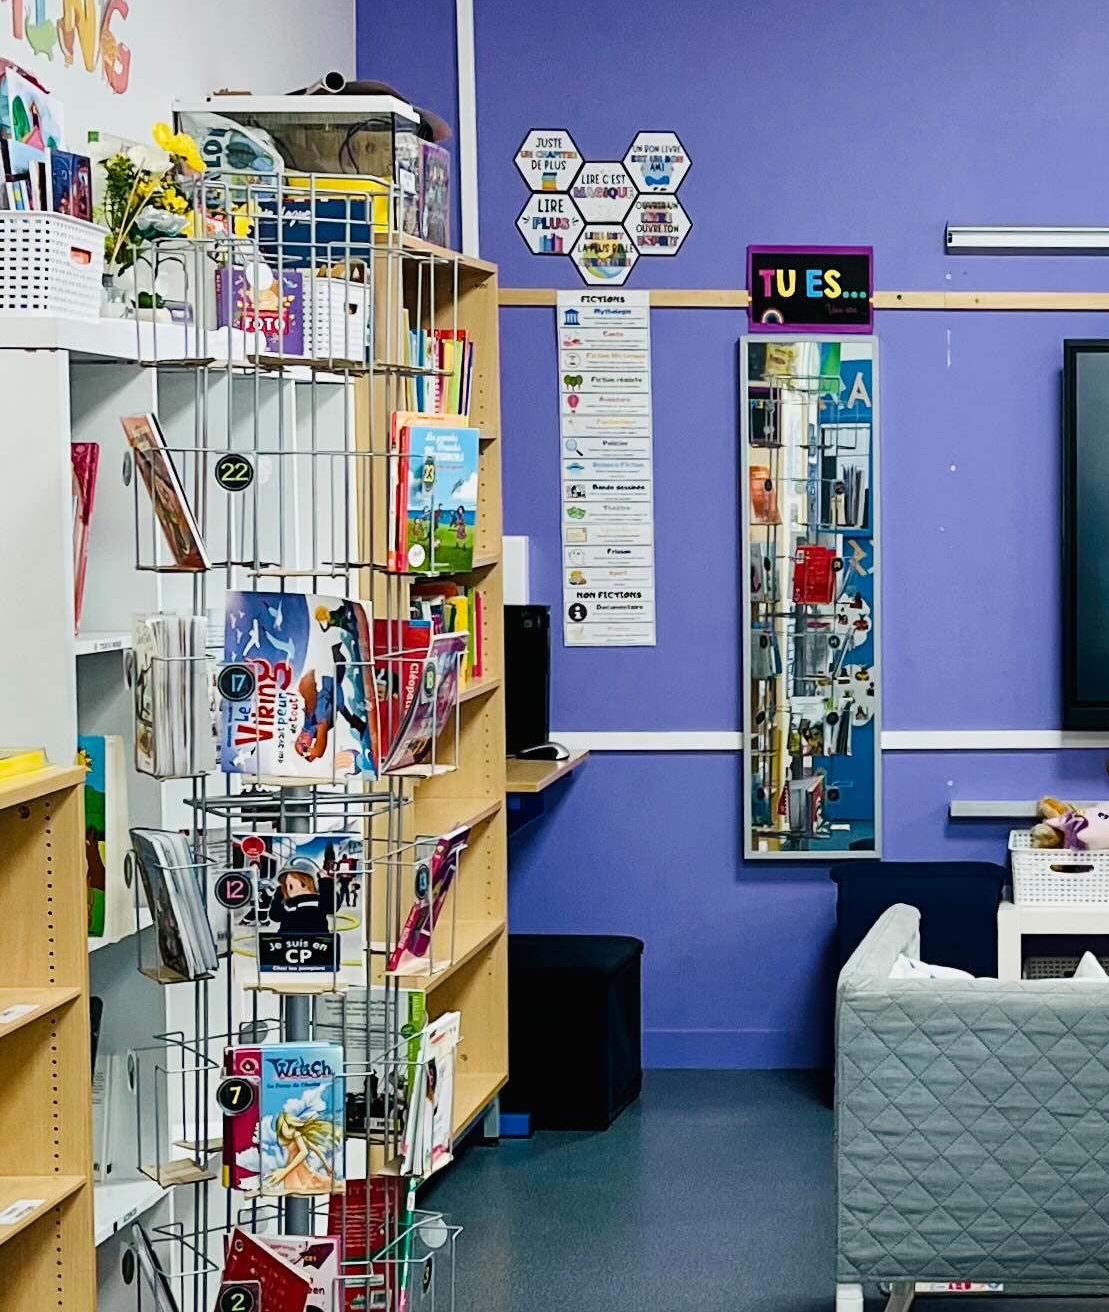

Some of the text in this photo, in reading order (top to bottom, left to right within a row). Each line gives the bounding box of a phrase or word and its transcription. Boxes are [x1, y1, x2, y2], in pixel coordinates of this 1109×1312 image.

[536, 138, 563, 148] JUSTE
[531, 160, 567, 171] DE PLUS
[581, 174, 626, 184] LIRE C'EST
[538, 199, 564, 213] LIRE
[532, 217, 570, 230] PLUS
[758, 269, 796, 298] TU
[580, 295, 625, 304] FICTIONS
[221, 462, 249, 481] 22
[576, 591, 642, 599] NON FICTIONS
[231, 673, 247, 692] 17
[404, 662, 419, 715] Cléopa
[234, 706, 251, 722] Le
[277, 692, 288, 725] peur
[226, 881, 243, 899] 12
[269, 938, 328, 952] Je suis en
[285, 949, 312, 964] CP
[229, 1086, 241, 1104] 7
[231, 1293, 245, 1312] 2
